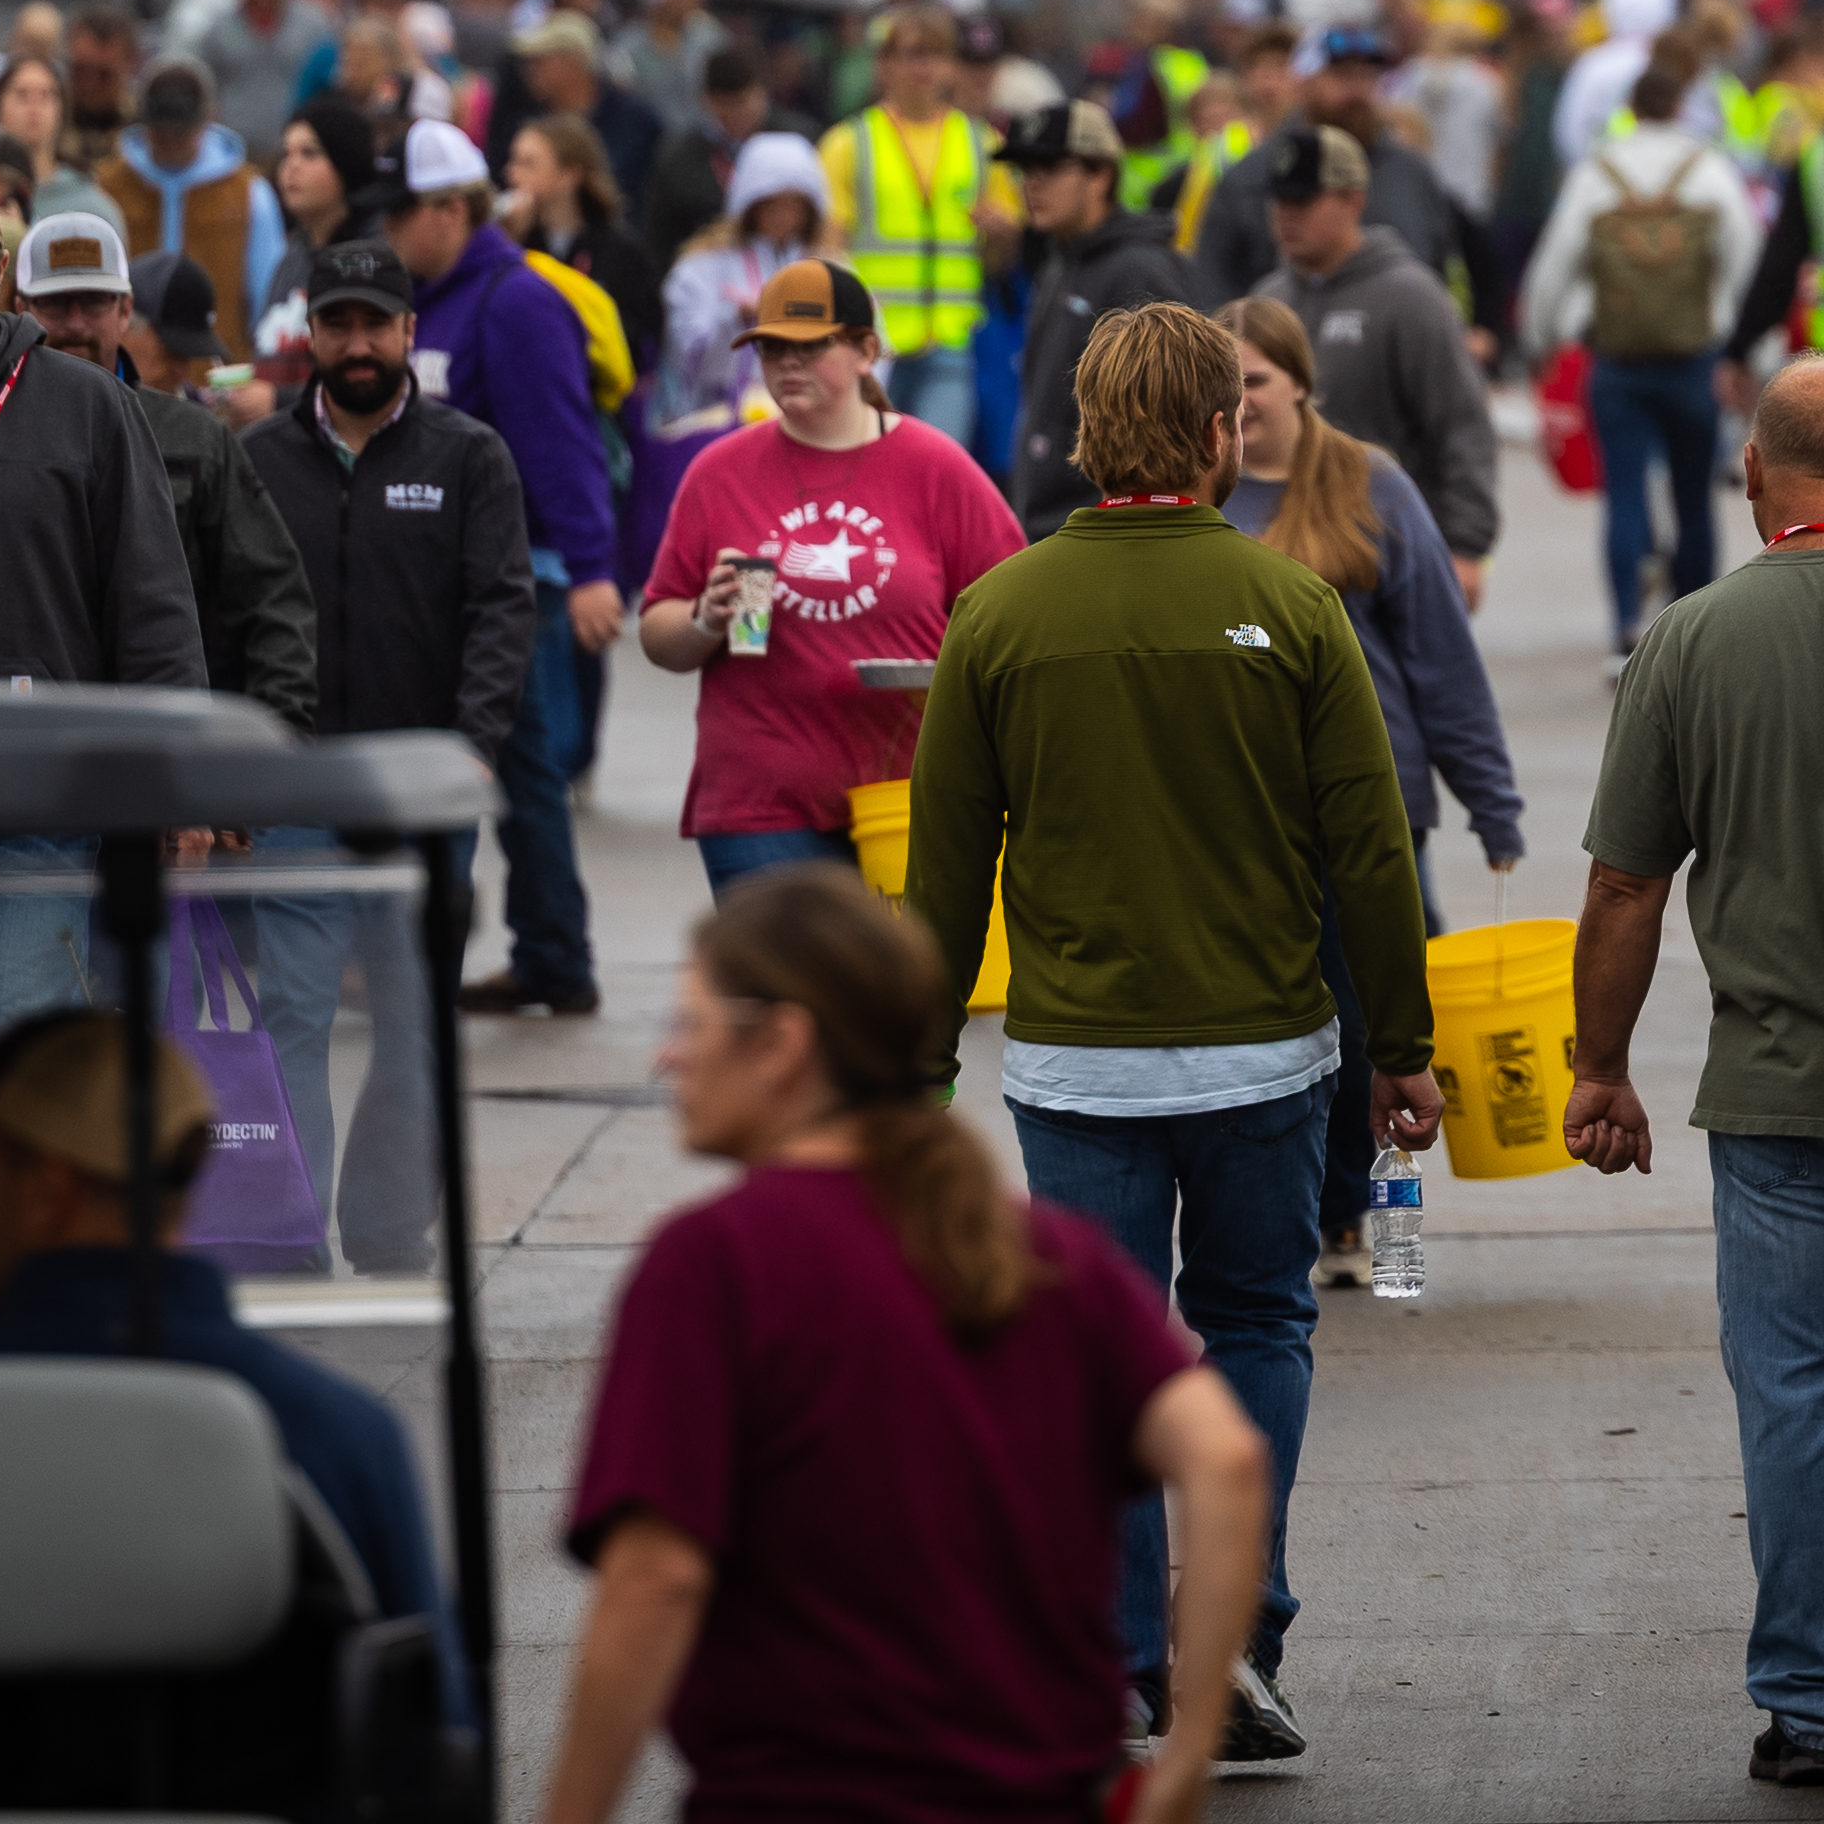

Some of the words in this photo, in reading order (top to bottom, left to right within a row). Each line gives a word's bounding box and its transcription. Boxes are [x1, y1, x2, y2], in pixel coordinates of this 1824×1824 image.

[779, 501, 819, 532] WE
[825, 500, 884, 536] ARE
[772, 581, 878, 622] STELLAR
